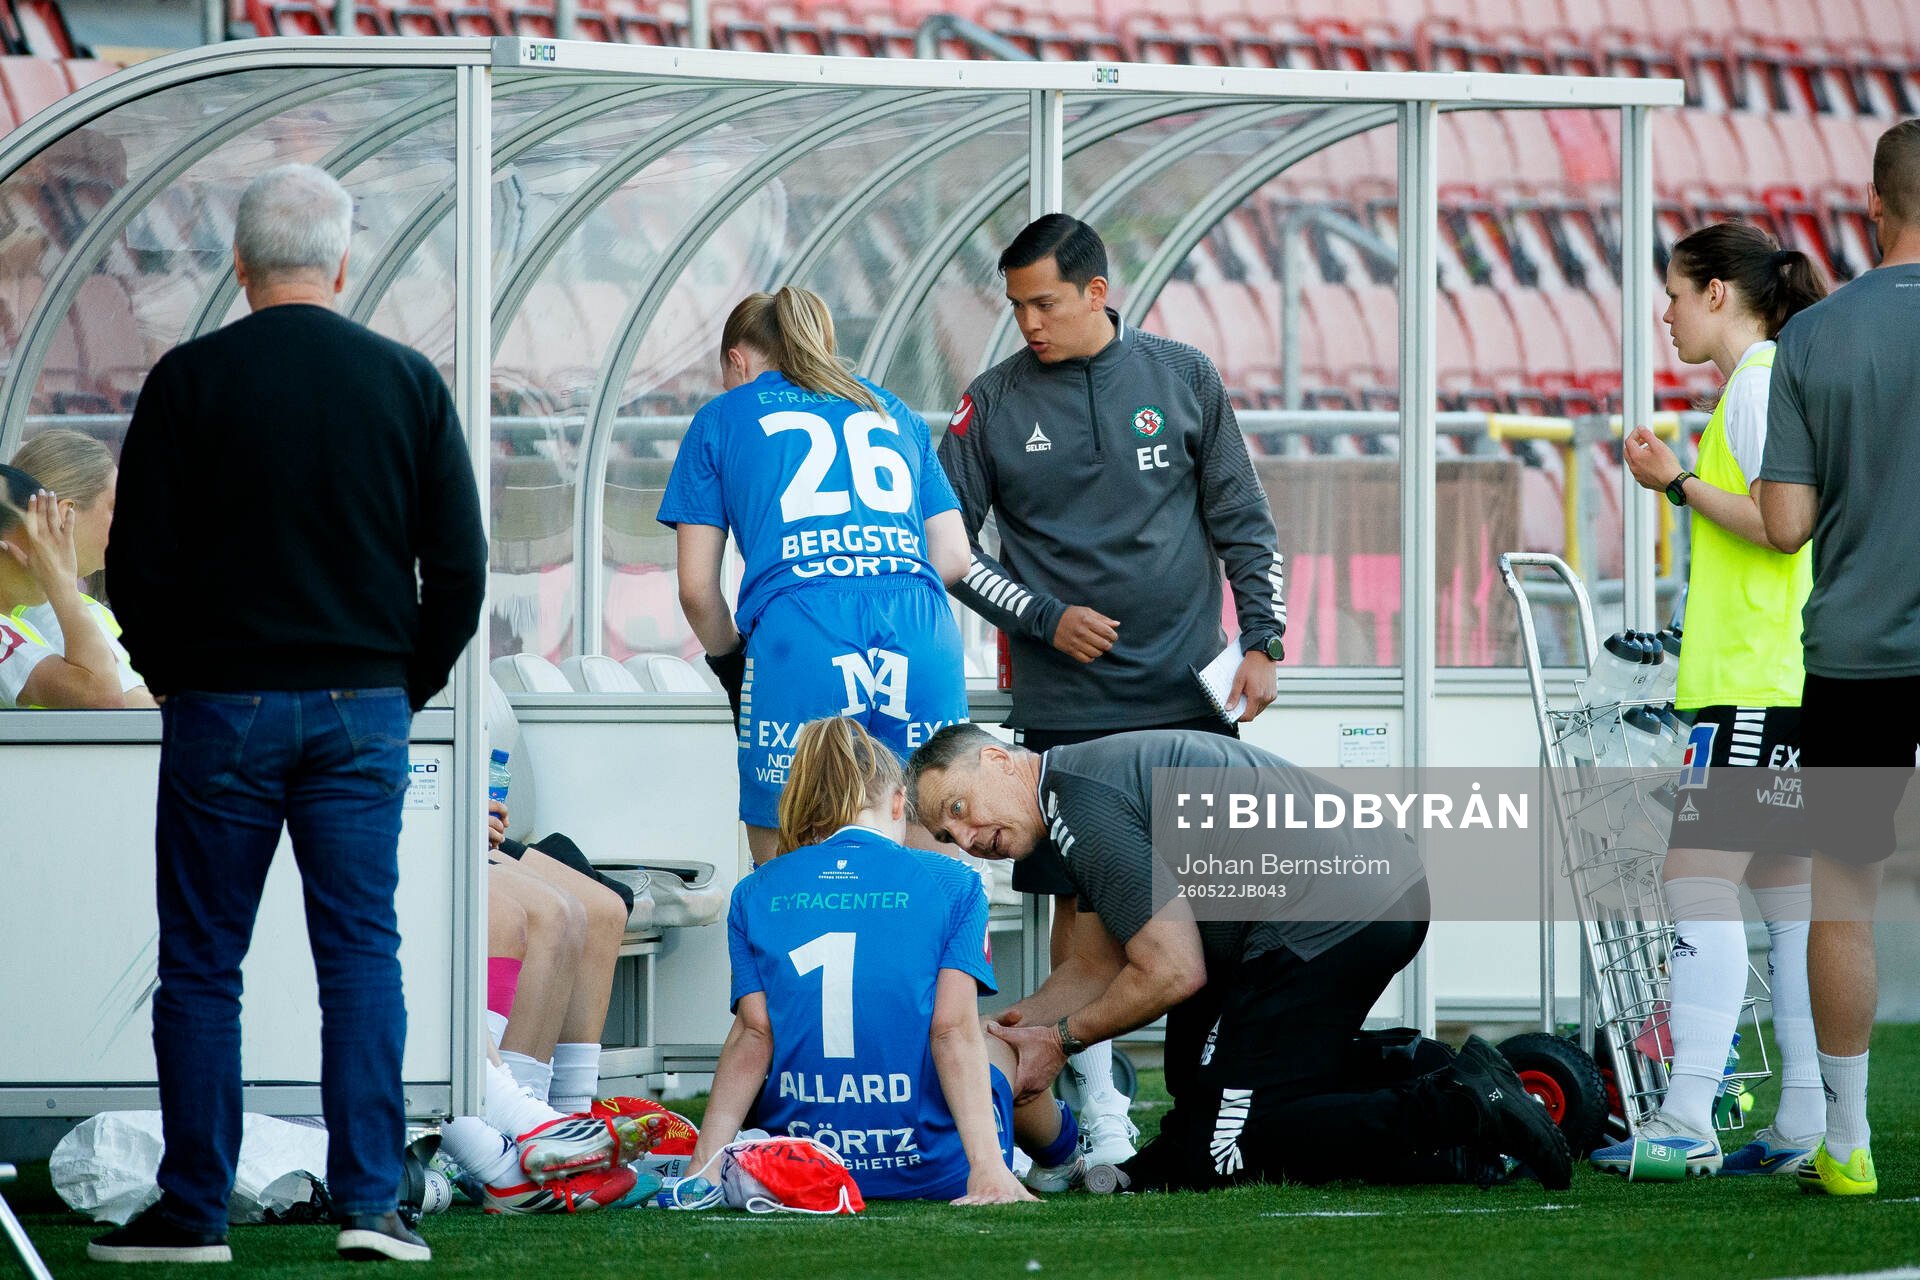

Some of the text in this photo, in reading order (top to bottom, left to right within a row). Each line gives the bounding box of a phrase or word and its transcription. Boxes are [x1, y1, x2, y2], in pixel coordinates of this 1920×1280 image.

[529, 44, 556, 61] DACO
[1096, 67, 1119, 84] DACO
[1025, 442, 1052, 453] SELECT
[1136, 444, 1170, 471] EC
[758, 411, 912, 523] 26
[1342, 728, 1387, 736] DACO
[1678, 813, 1700, 822] SELECT
[770, 891, 910, 912] EYRACENTER
[788, 931, 857, 1059] 1
[779, 1071, 912, 1104] ALLARD
[671, 1159, 681, 1177] ELECT
